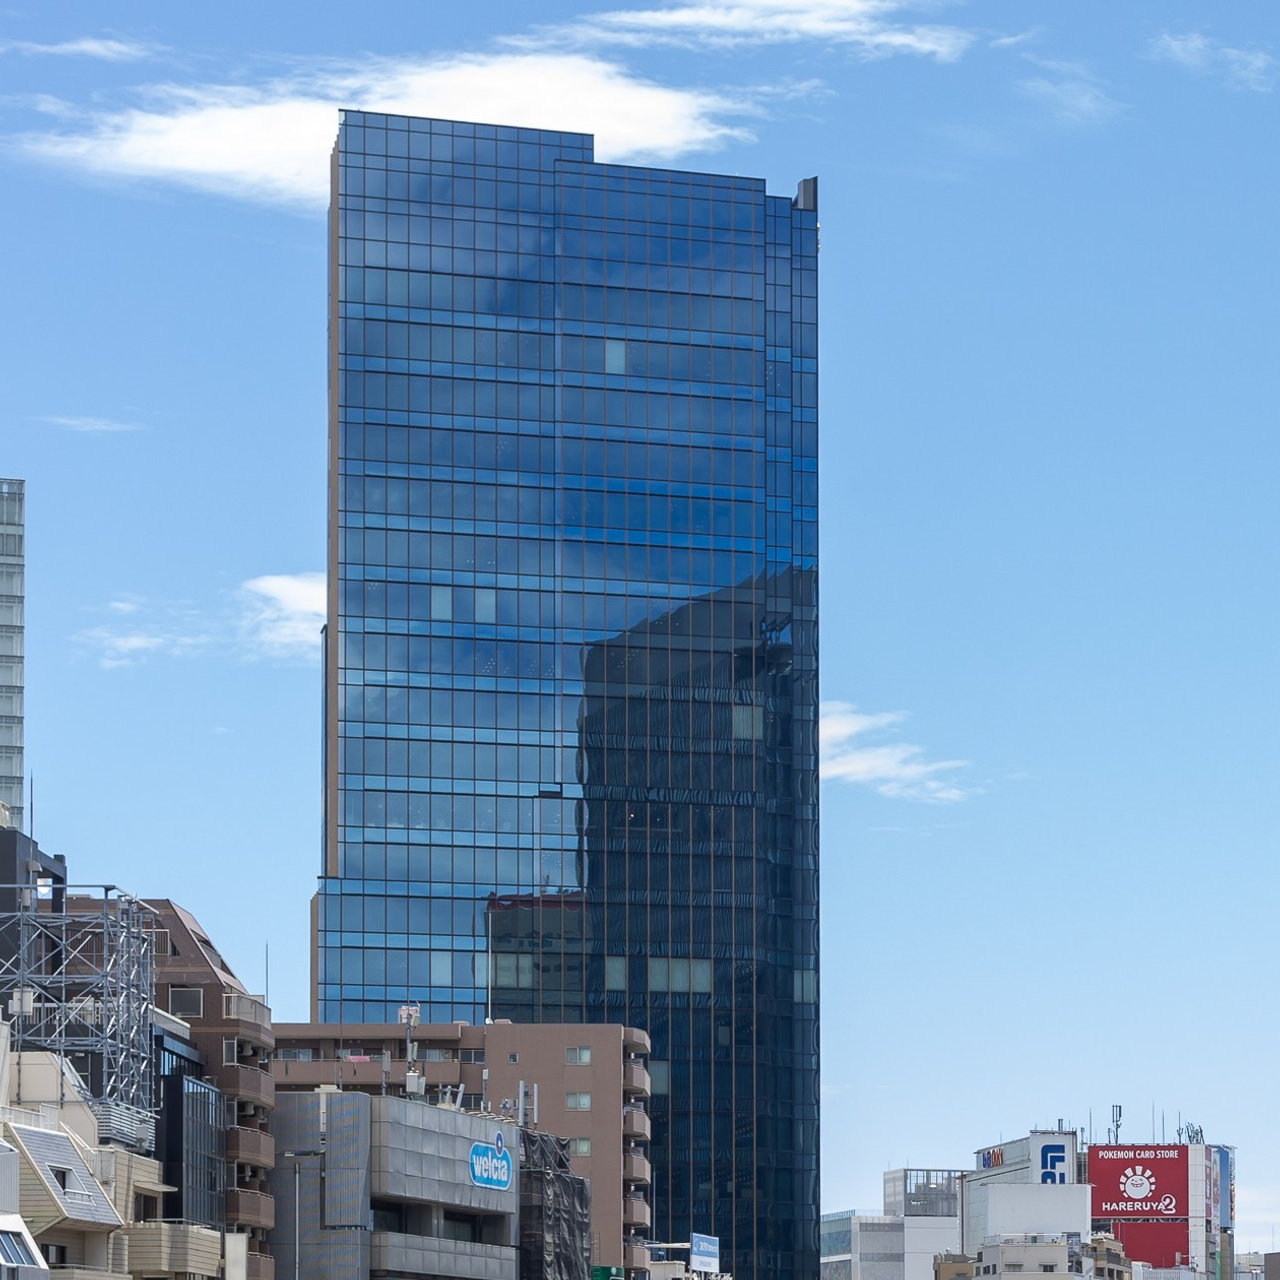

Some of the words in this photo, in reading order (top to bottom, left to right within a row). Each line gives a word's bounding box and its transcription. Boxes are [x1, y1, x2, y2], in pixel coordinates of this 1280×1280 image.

[1099, 1151, 1134, 1159] POKEMON
[1135, 1151, 1155, 1159] CARD
[1156, 1150, 1179, 1159] STORE
[472, 1151, 507, 1181] welcia
